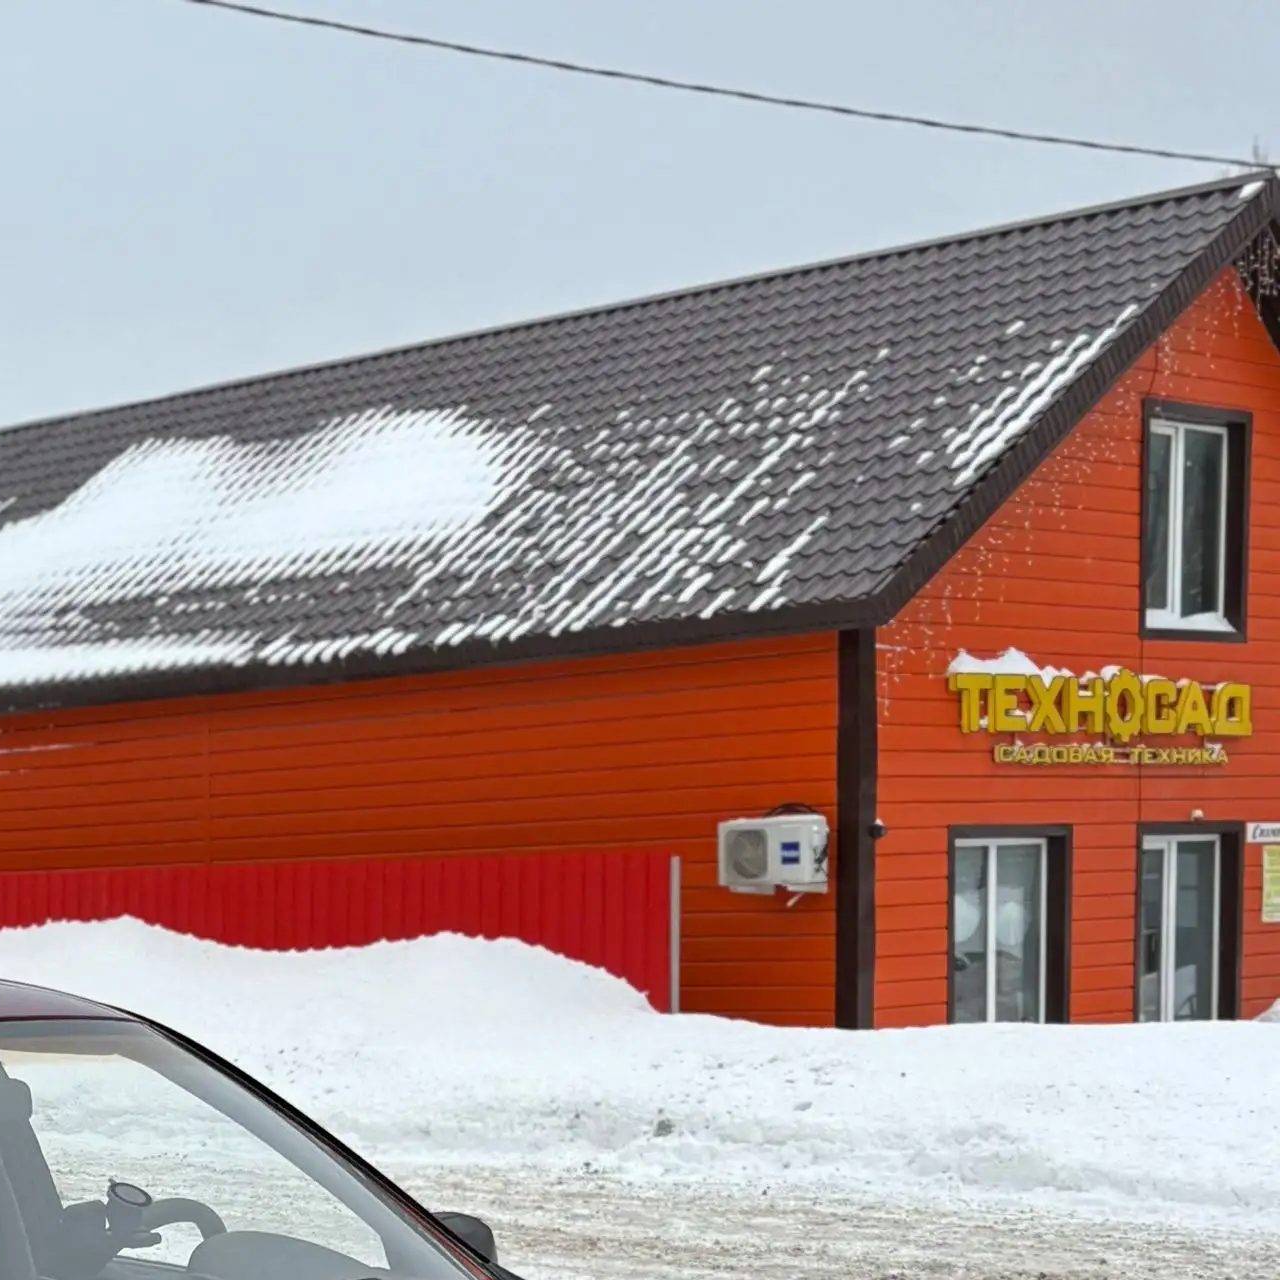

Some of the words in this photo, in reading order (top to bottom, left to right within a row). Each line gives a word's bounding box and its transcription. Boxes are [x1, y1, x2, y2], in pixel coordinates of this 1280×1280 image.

[951, 668, 1253, 742] ТЕХНОСАД
[994, 745, 1115, 766] САДОВАЯ
[1130, 747, 1229, 765] ТЕХНИКА
